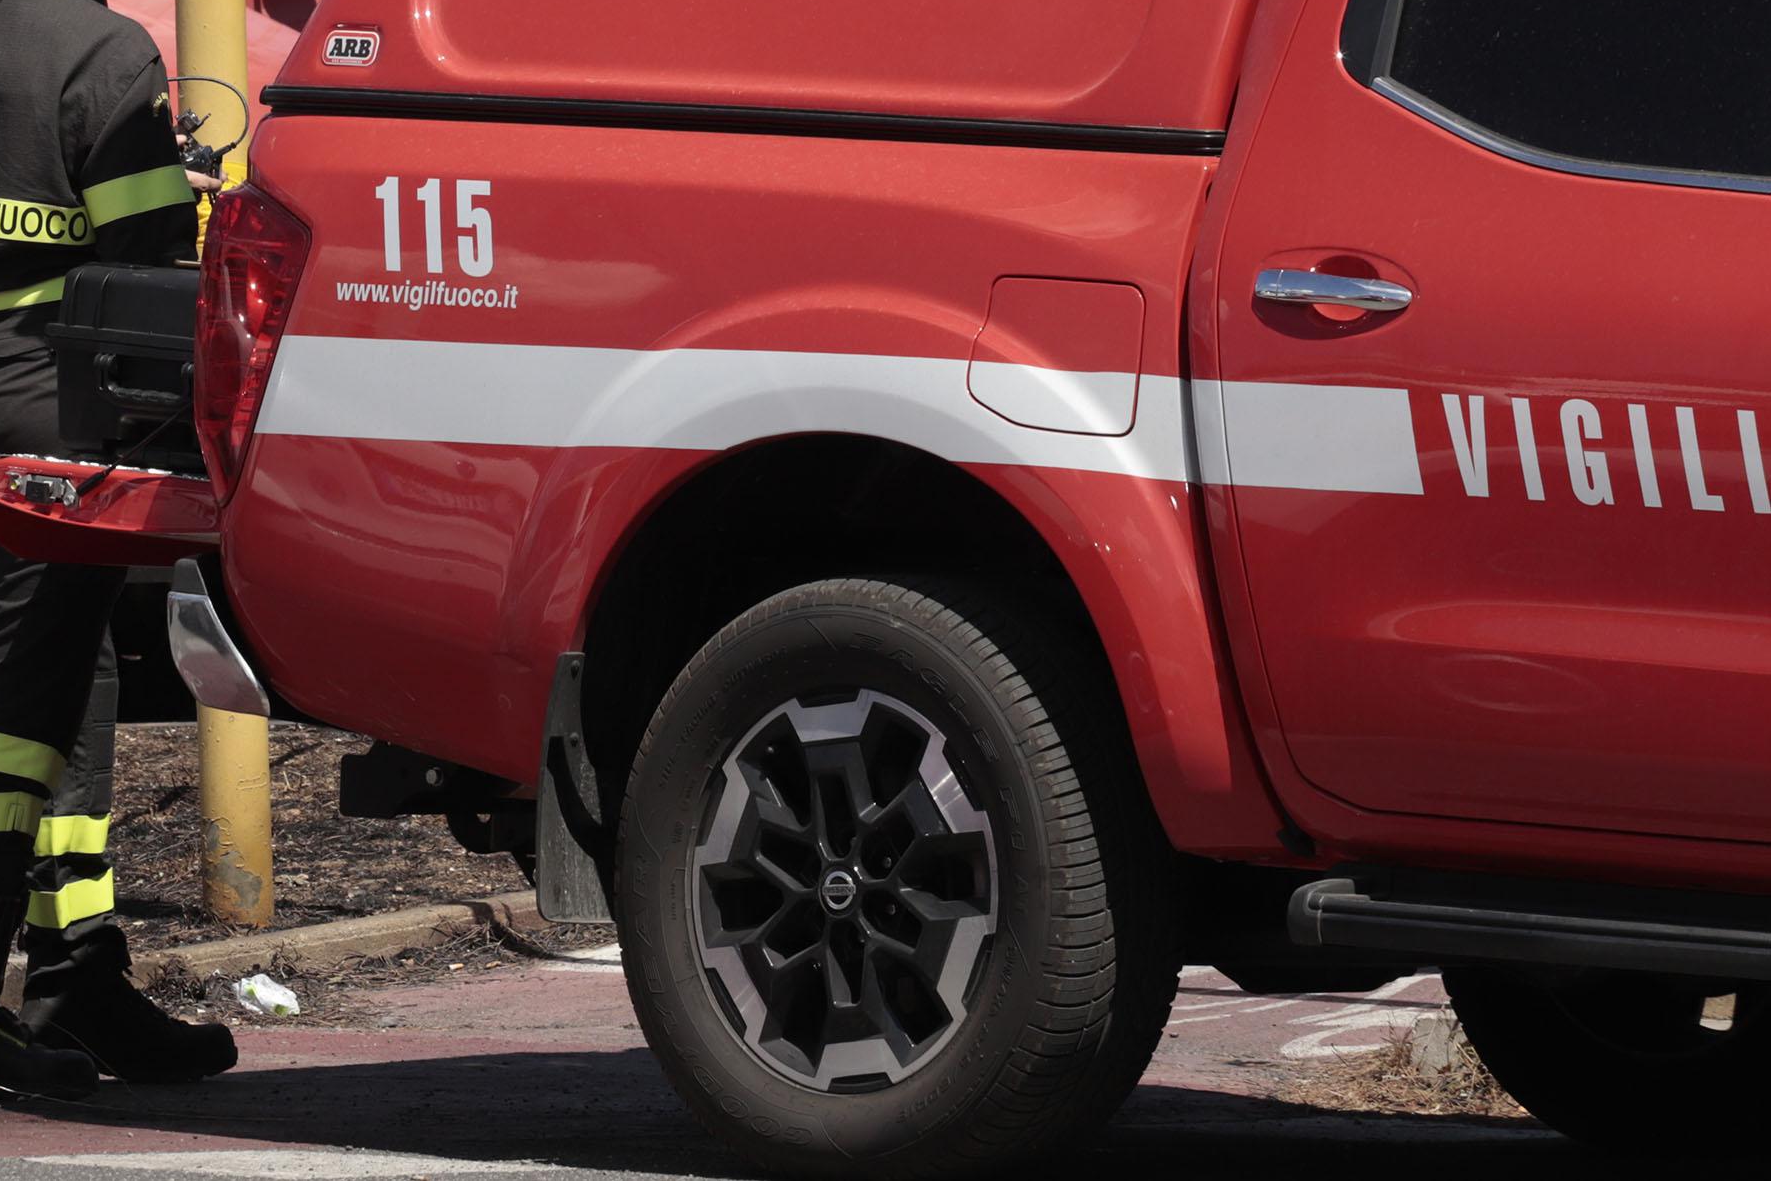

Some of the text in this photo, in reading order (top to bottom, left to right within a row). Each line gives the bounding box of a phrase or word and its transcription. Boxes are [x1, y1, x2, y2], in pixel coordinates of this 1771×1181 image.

[329, 38, 372, 58] ARB
[375, 176, 494, 278] 115
[336, 280, 519, 311] www.vigilfuoco.it
[1441, 393, 1771, 514] VIGILI
